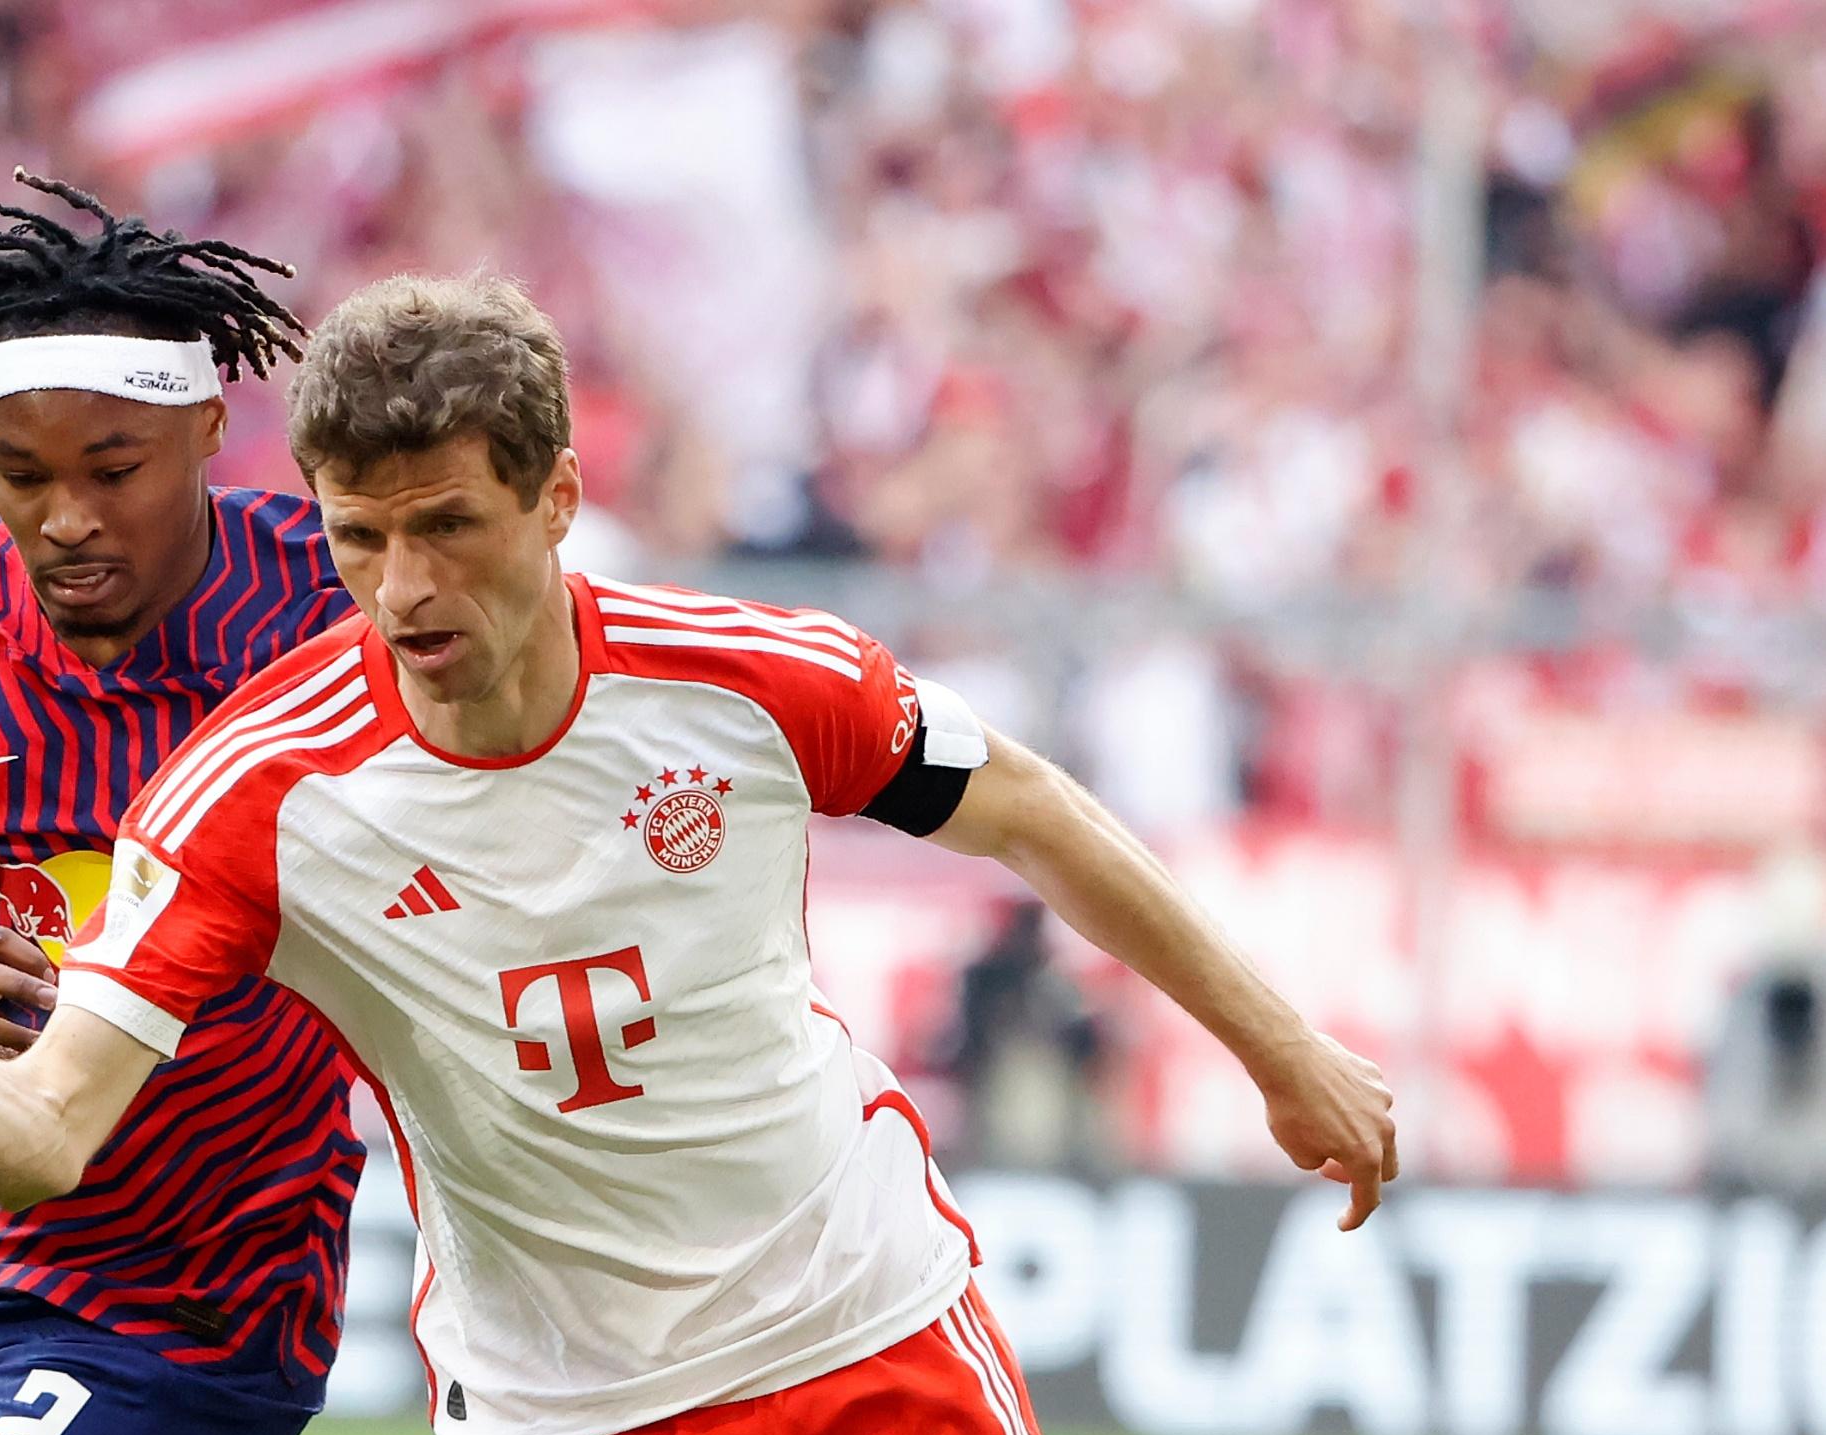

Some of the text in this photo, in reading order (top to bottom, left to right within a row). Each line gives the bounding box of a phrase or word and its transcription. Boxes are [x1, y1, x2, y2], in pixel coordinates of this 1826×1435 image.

[890, 664, 918, 755] QAT
[650, 796, 715, 837] FC BAYERN
